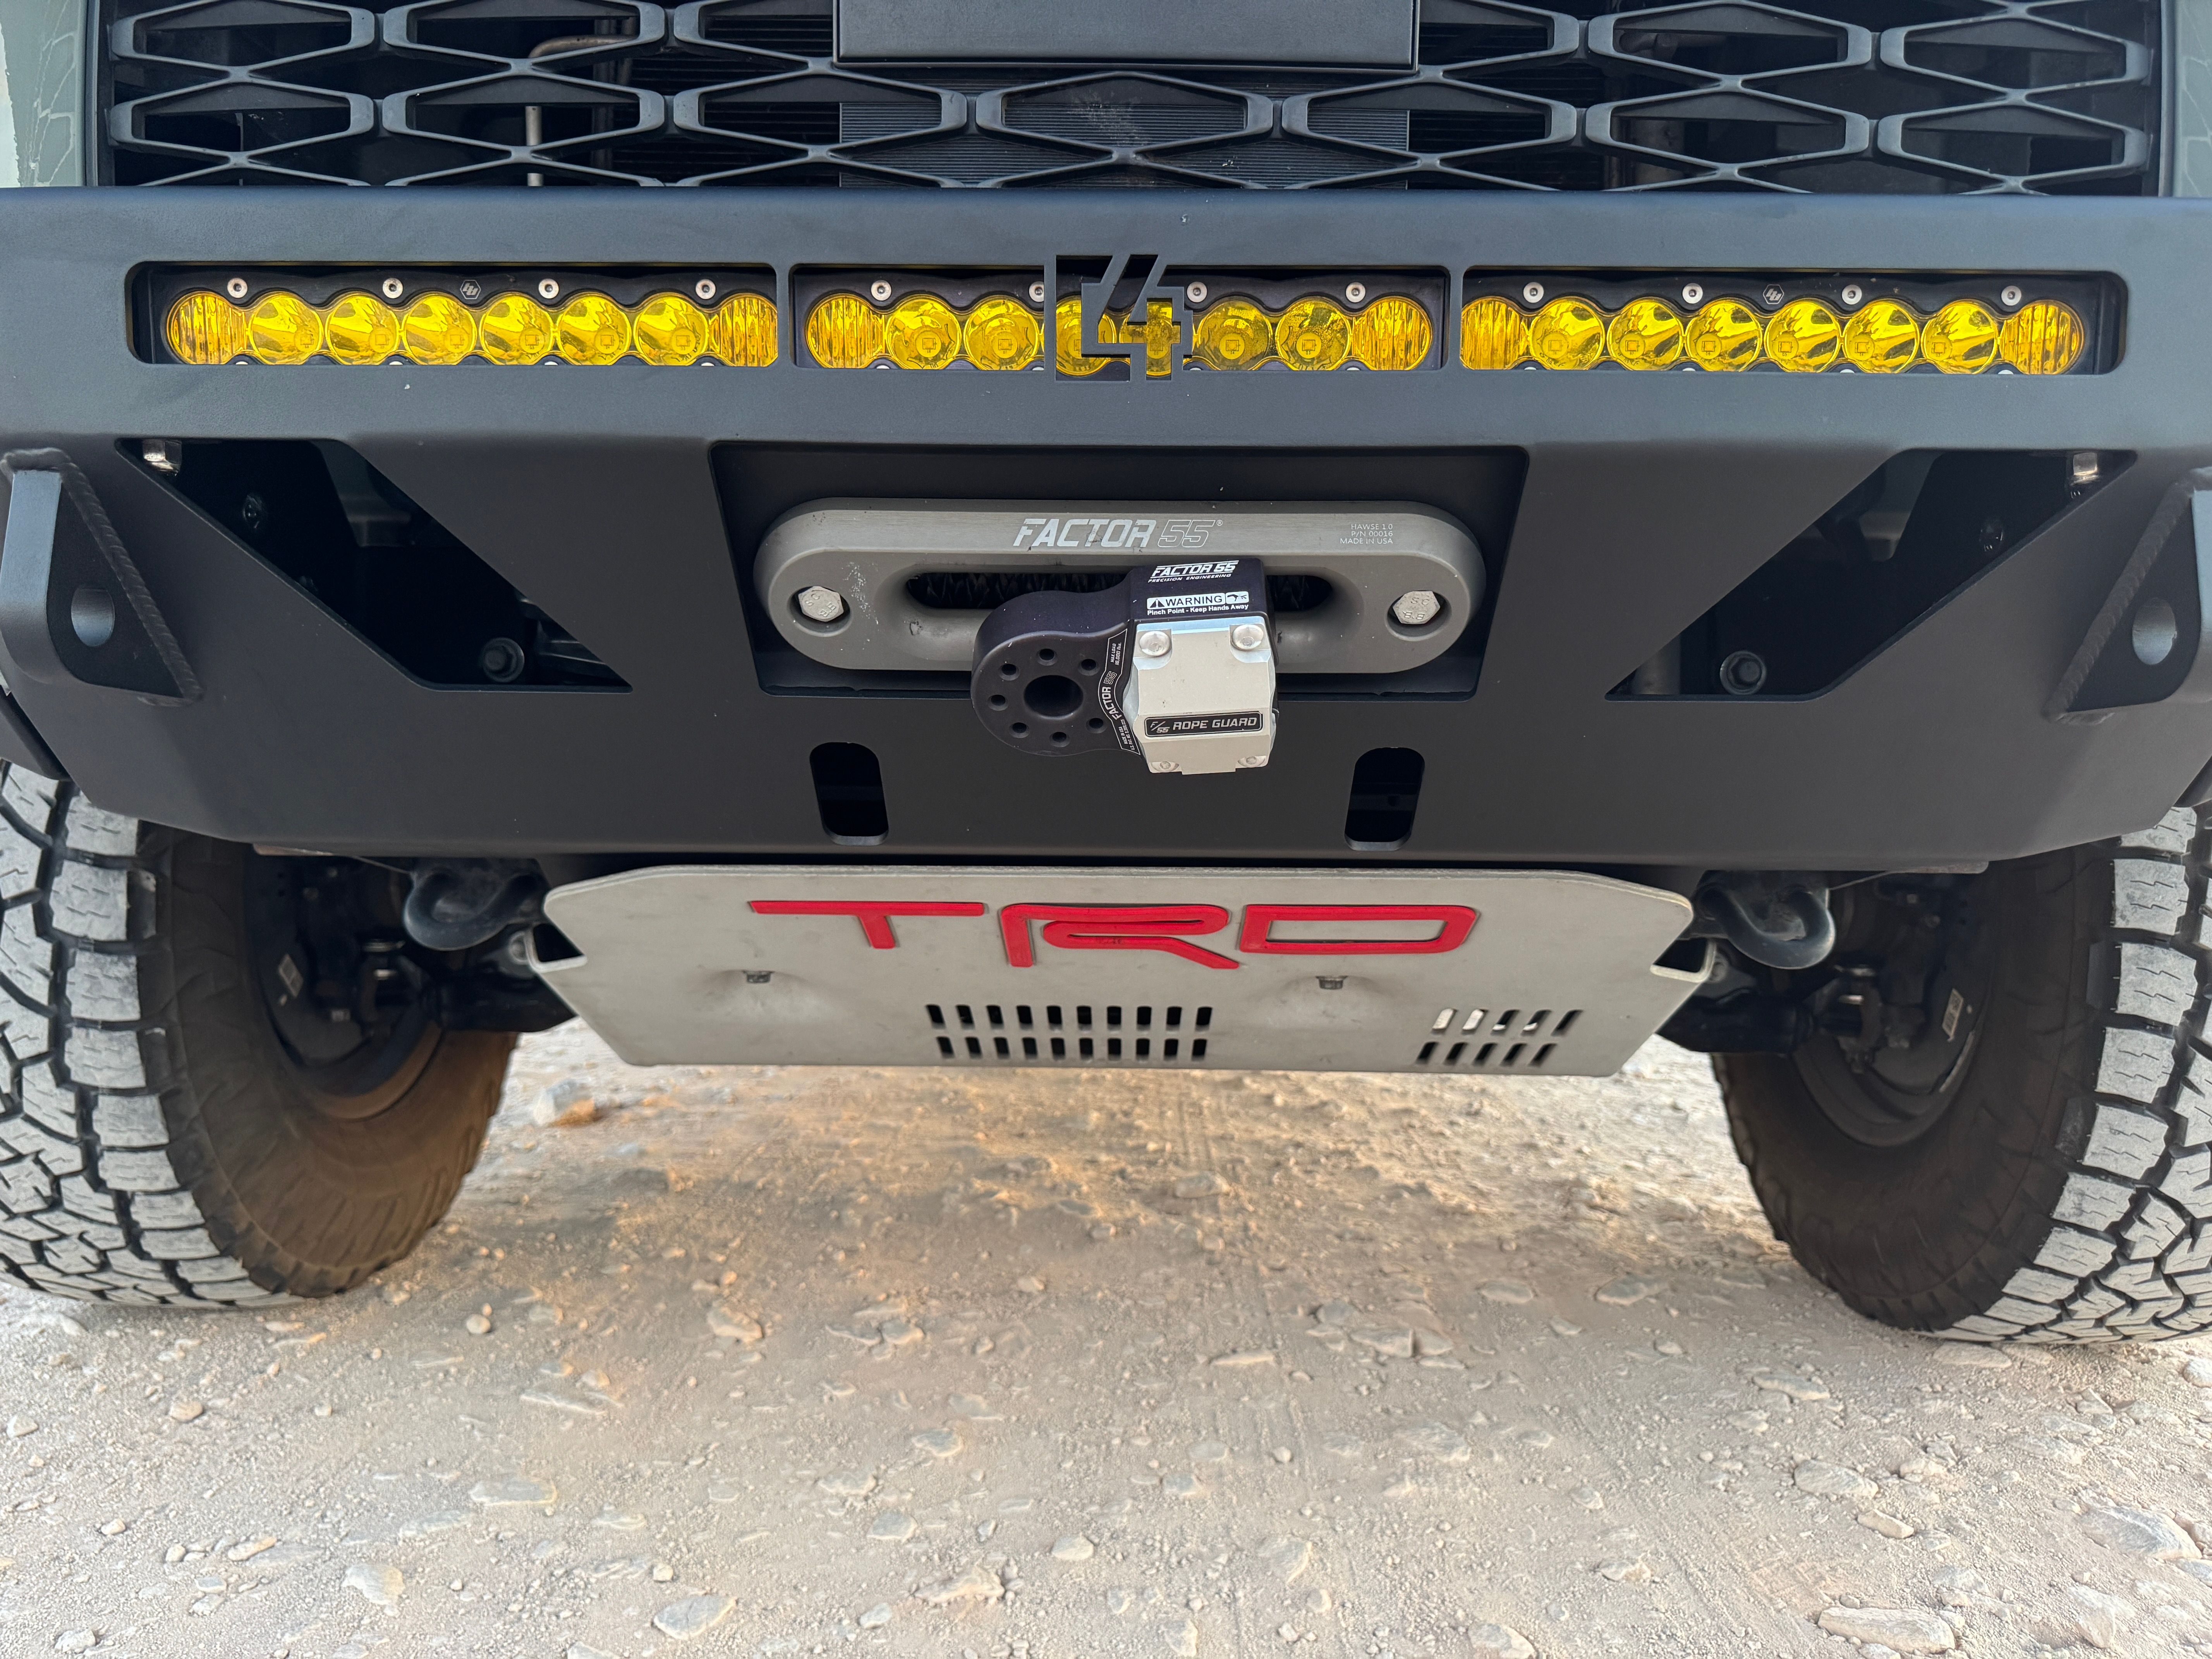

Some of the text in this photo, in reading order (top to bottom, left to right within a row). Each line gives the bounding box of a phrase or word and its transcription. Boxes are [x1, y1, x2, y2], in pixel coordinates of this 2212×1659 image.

[1013, 518, 1157, 548] FACTOR
[1151, 562, 1238, 577] FACTOR 55
[1166, 595, 1223, 606] WARNING
[1102, 671, 1122, 720] FACTOR 55
[1173, 720, 1209, 730] ROPE
[1211, 718, 1257, 728] GUARD
[749, 900, 1477, 969] TRD
